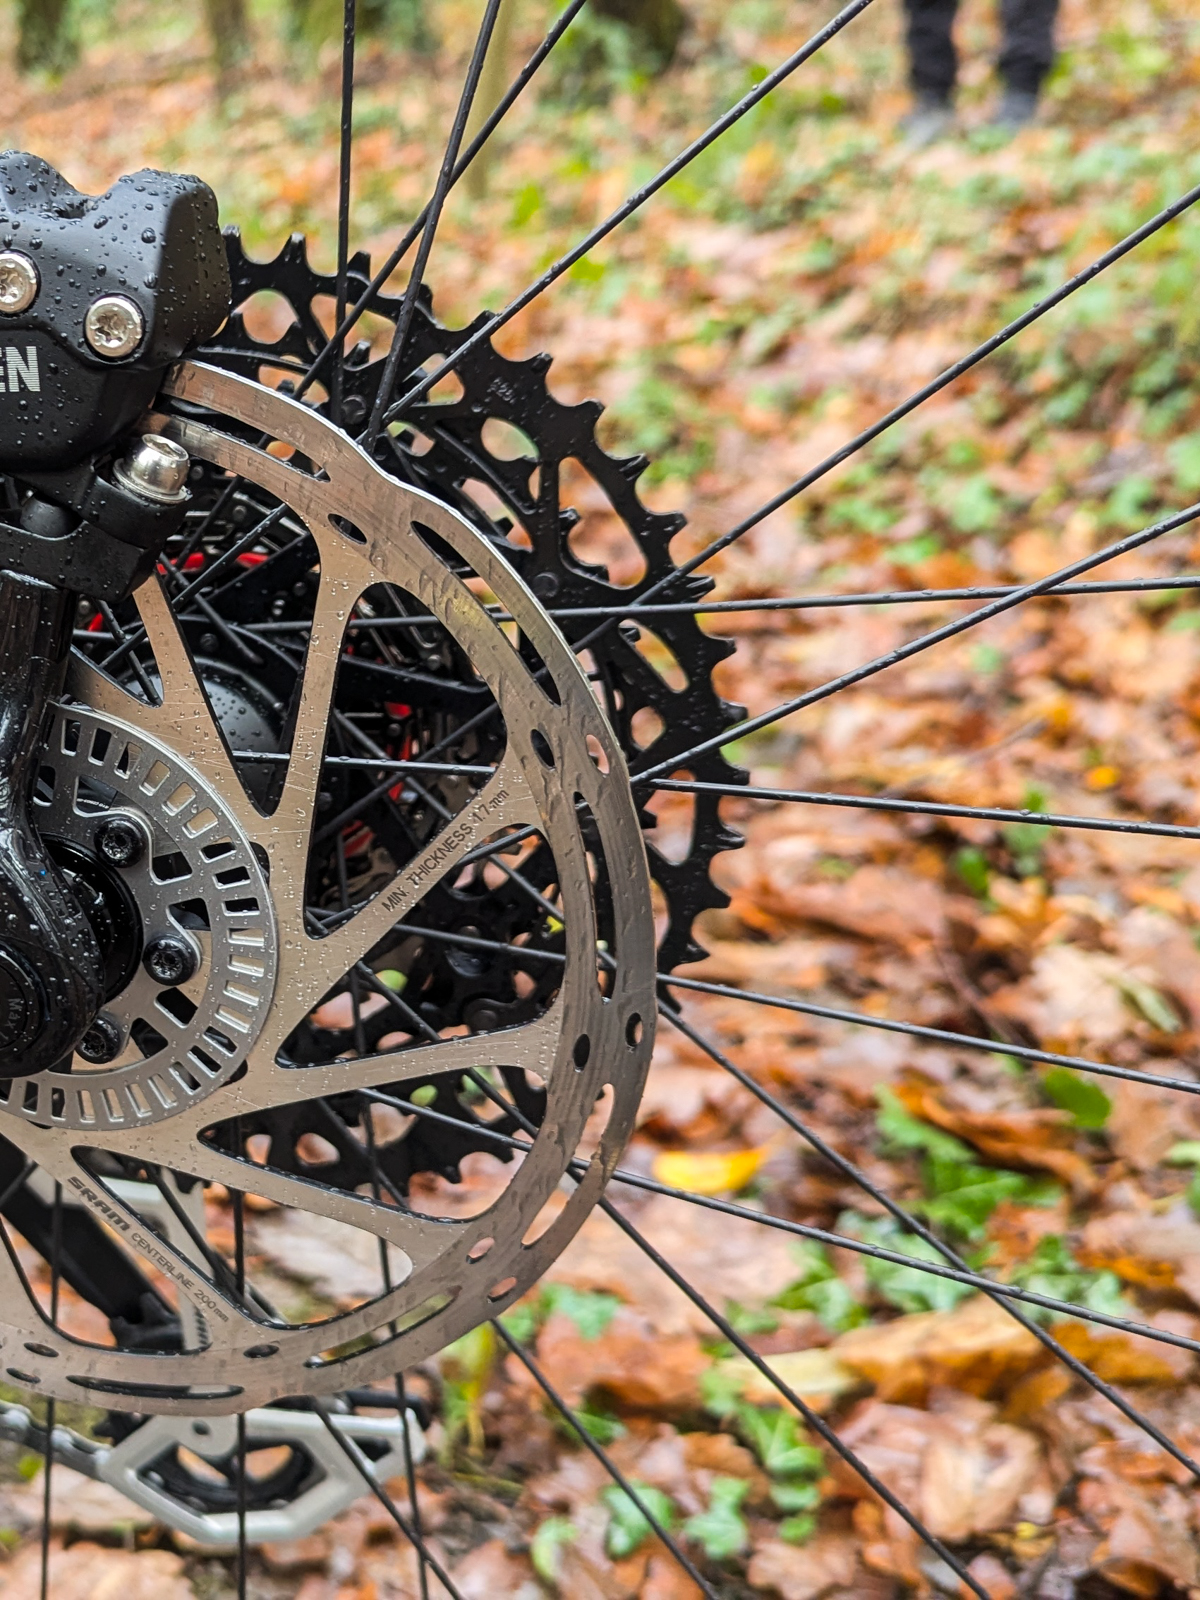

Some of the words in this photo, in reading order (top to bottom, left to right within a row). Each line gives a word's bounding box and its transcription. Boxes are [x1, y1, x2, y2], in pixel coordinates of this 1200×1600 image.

[406, 822, 473, 886] THICKNESS
[67, 1176, 132, 1231] SRAM
[131, 1232, 195, 1290] CENTERLINE
